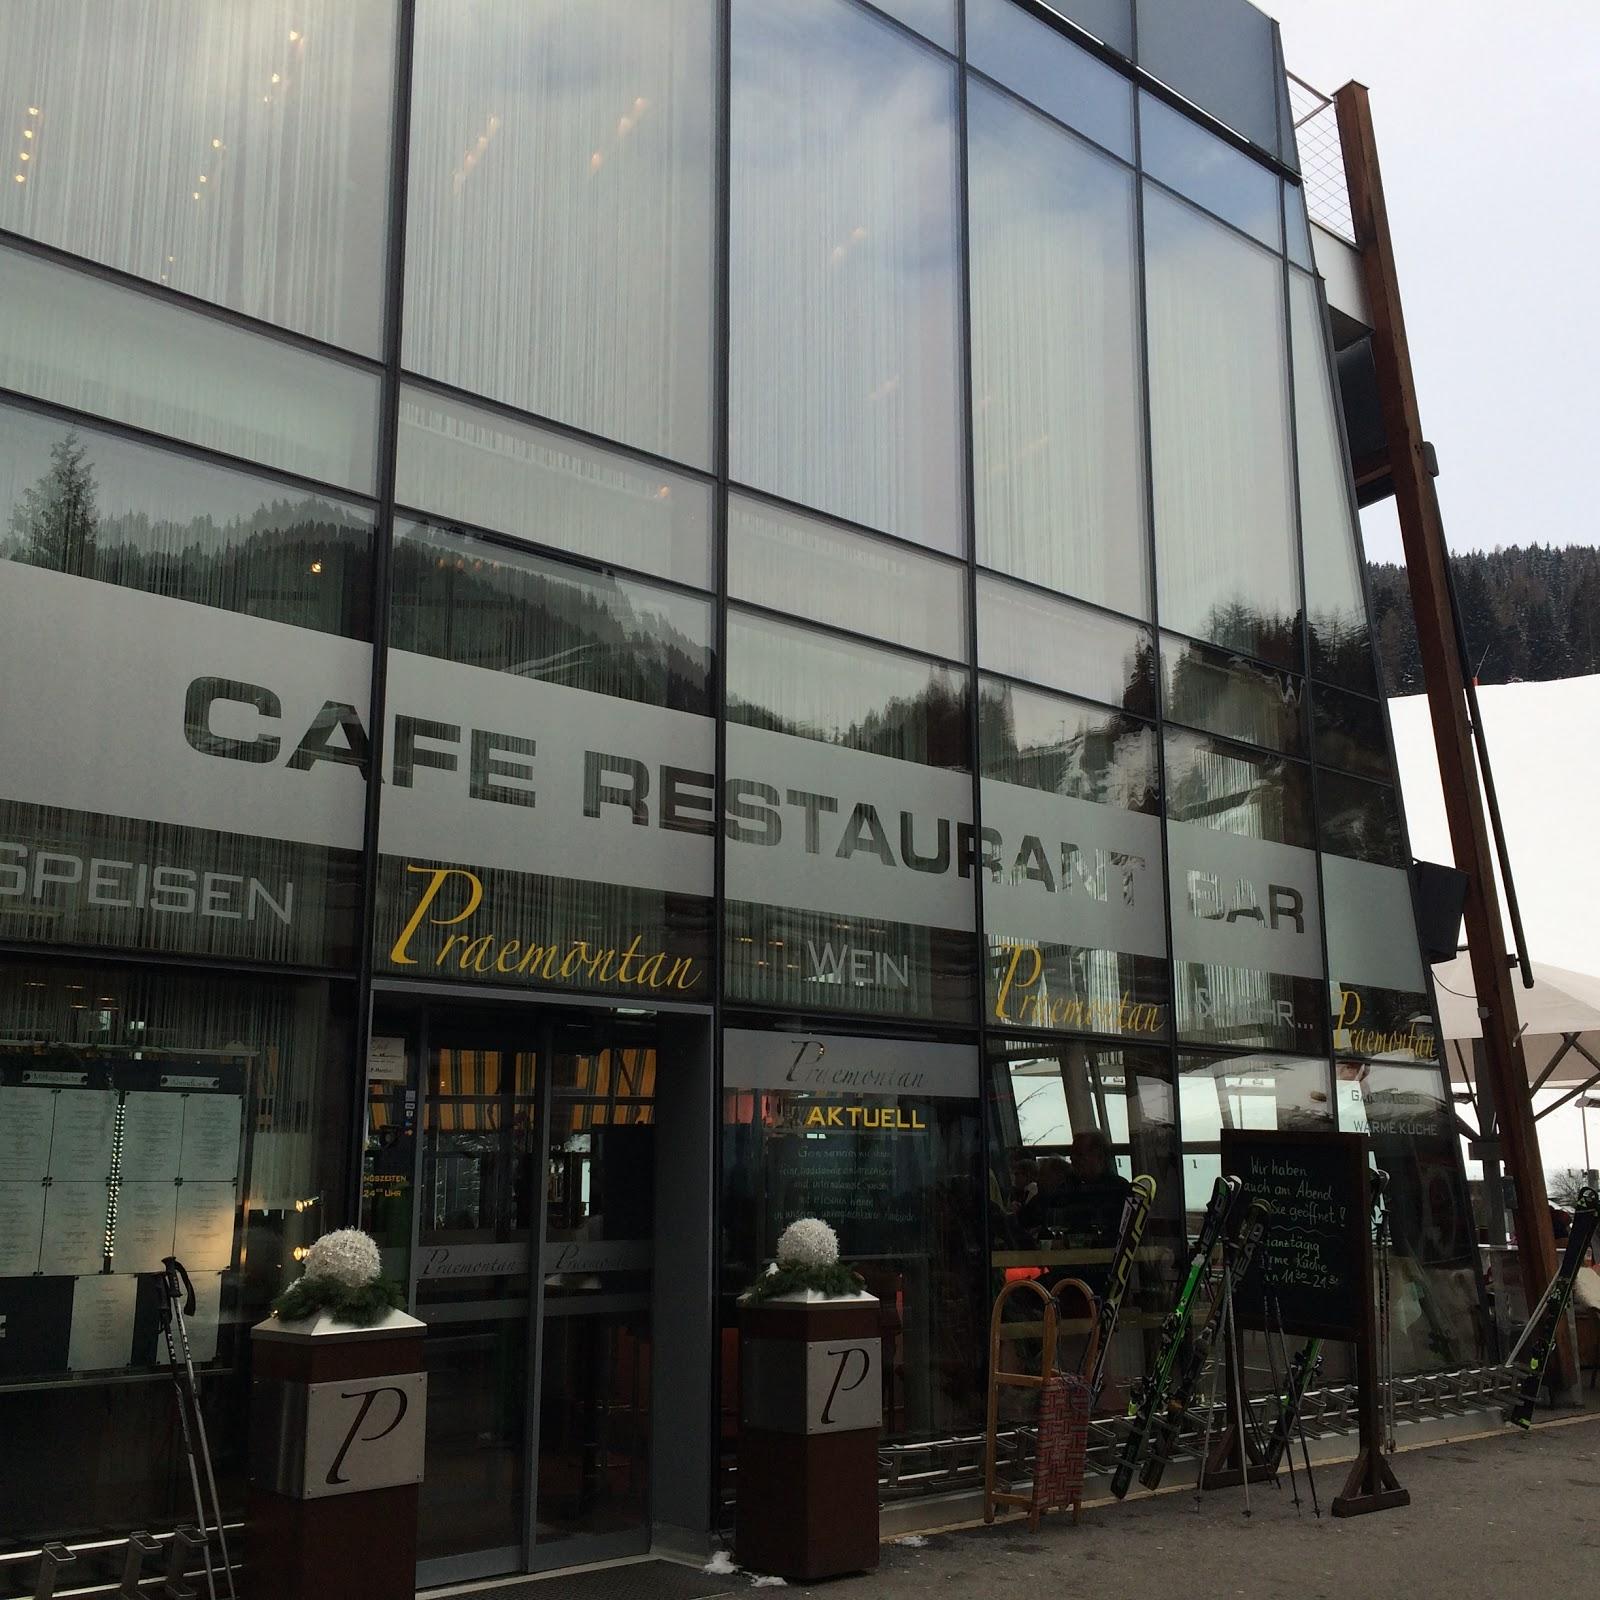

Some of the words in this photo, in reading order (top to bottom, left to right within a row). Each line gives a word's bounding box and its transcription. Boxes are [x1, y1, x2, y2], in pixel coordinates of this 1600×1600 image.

[184, 676, 536, 808] CAFE
[583, 750, 1146, 909] RESTAURANT
[1187, 869, 1304, 934] BAR
[0, 841, 293, 925] SPEISEN
[390, 863, 702, 989] Praemontan
[807, 940, 909, 988] WEIN
[1333, 990, 1440, 1059] Praemontan
[806, 1105, 926, 1129] AKTUELL
[1243, 1178, 1271, 1194] auch
[1274, 1185, 1291, 1196] am
[1295, 1179, 1333, 1201] Abend
[1250, 1156, 1269, 1175] Wir
[1271, 1159, 1308, 1176] haben
[1270, 1199, 1286, 1215] Sie
[1265, 1232, 1321, 1259] anztägig
[821, 1347, 871, 1425] P
[324, 1386, 408, 1485] P
